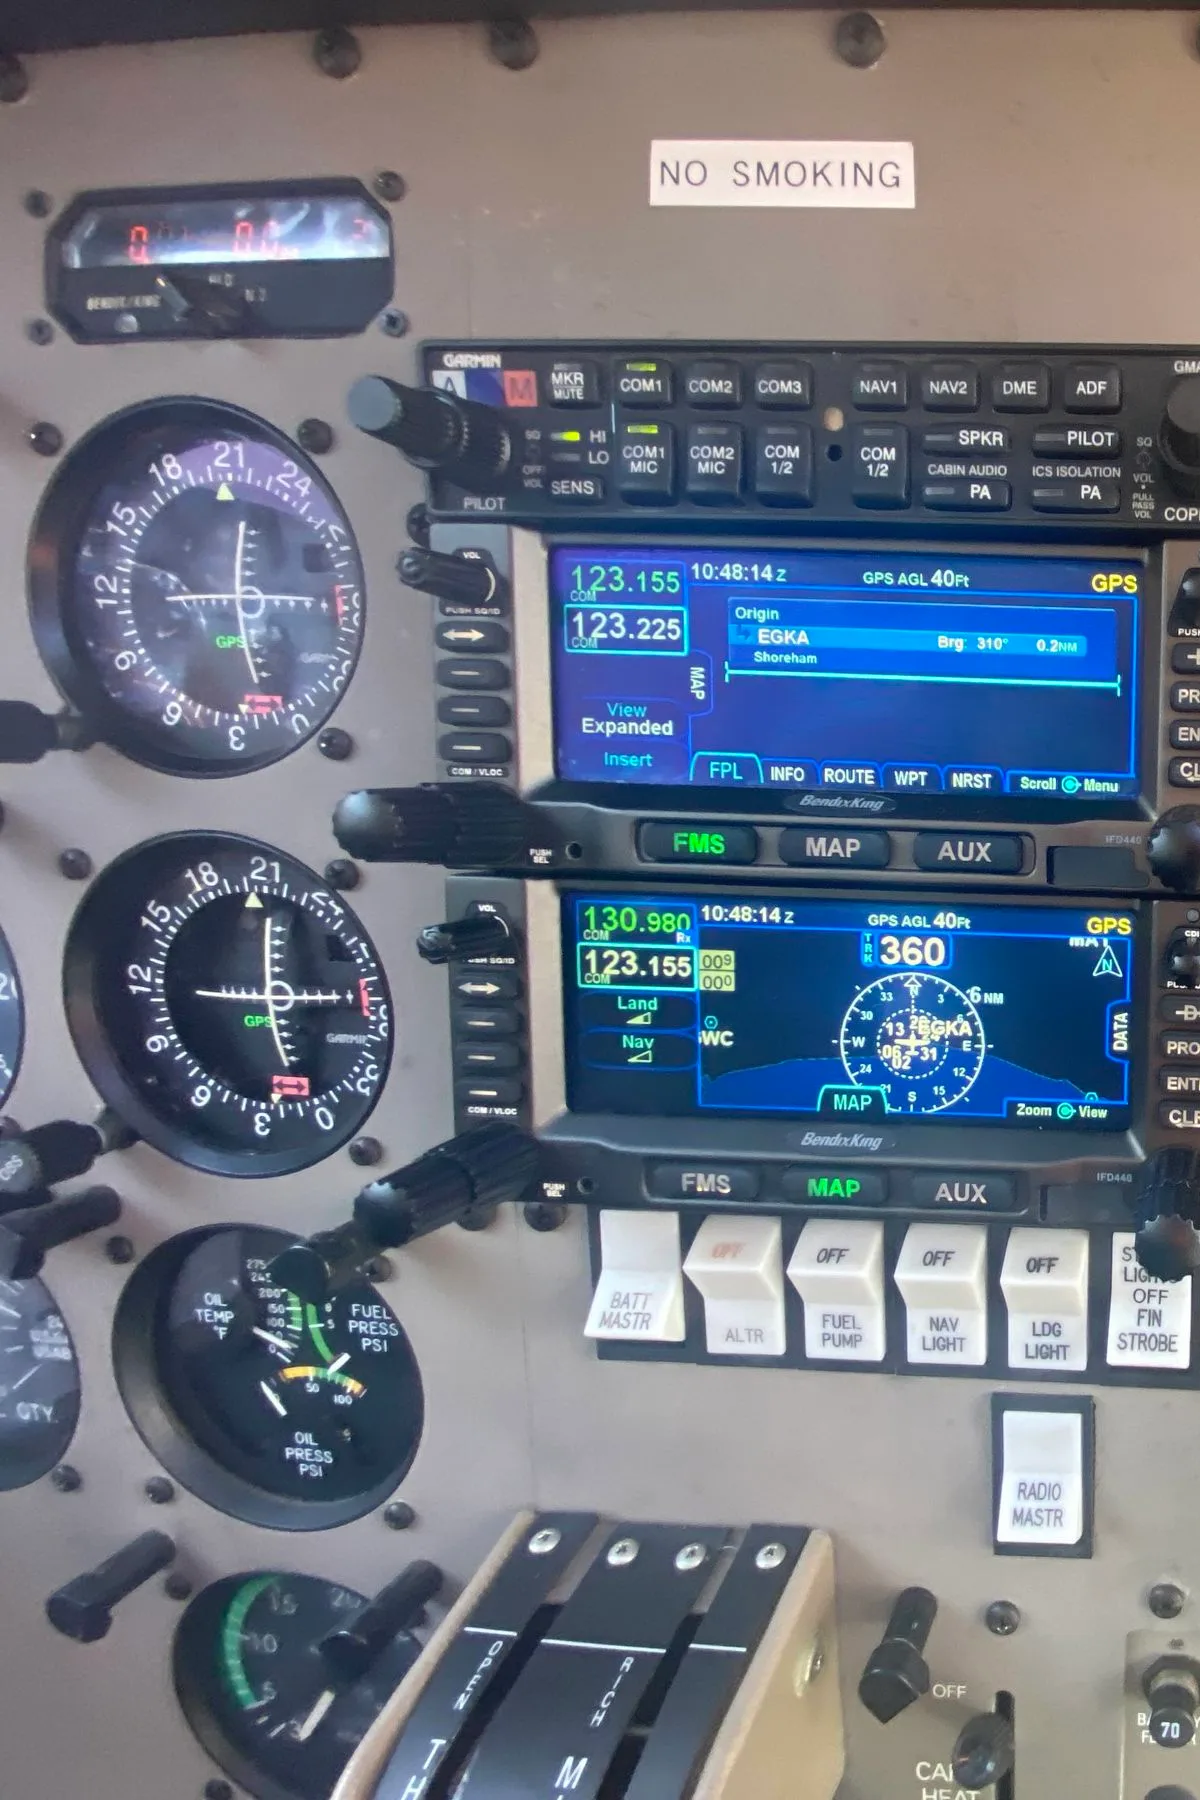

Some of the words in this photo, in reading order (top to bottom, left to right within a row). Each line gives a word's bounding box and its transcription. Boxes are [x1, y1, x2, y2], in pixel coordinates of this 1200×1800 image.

[660, 160, 708, 187] NO
[732, 160, 901, 188] SMOKING
[443, 354, 501, 368] GARMIN
[552, 372, 584, 385] MKR
[620, 378, 662, 392] COM1
[554, 388, 584, 400] MUTE
[689, 380, 732, 394] COM2
[758, 380, 802, 394] COM3
[860, 380, 897, 394] NAV1
[930, 381, 968, 394] NAV2
[1003, 381, 1037, 395] DME
[1076, 381, 1107, 395] ADF
[959, 430, 1004, 445] SPKR
[1067, 431, 1115, 447] PILOT
[213, 441, 245, 467] 21
[622, 446, 665, 459] COM1
[690, 446, 734, 459] COM2
[764, 446, 800, 458] COM
[860, 447, 896, 460] COM
[149, 453, 183, 485] 18
[630, 460, 658, 474] MIC
[698, 462, 726, 474] MIC
[928, 464, 966, 476] CABIN
[974, 464, 1008, 476] AUDIO
[1032, 466, 1053, 477] ICS
[1056, 466, 1121, 478] ISOLATION
[276, 461, 313, 497] 24
[551, 480, 594, 495] SENS
[970, 484, 991, 500] PA
[1080, 485, 1101, 500] PA
[464, 497, 505, 511] PILOT
[106, 502, 136, 537] 15
[571, 565, 680, 593] 123.155
[862, 572, 893, 585] GPS
[898, 572, 928, 587] AGL
[1091, 573, 1138, 593] GPS
[735, 607, 779, 622] Origin
[572, 612, 682, 640] 123.225
[758, 628, 810, 645] EGKA
[754, 651, 818, 664] Shoreham
[690, 666, 706, 700] MAP
[606, 702, 647, 717] View
[582, 718, 674, 737] Expanded
[604, 752, 652, 766] Insert
[709, 762, 743, 780] FPL
[770, 767, 804, 781] INFO
[824, 768, 875, 784] ROUTE
[894, 771, 927, 786] WPT
[953, 773, 991, 788] NRST
[1020, 776, 1056, 790] Scroll
[1084, 778, 1118, 792] Menu
[672, 832, 726, 855] FMS
[805, 837, 861, 859] MAP
[937, 841, 992, 863] AUX
[185, 861, 219, 892] 18
[250, 856, 280, 883] 21
[584, 906, 691, 933] 130.980
[868, 914, 898, 926] GPS
[902, 915, 930, 928] AGL
[1087, 918, 1132, 934] GPS
[880, 936, 946, 966] 360
[585, 950, 692, 977] 123.155
[618, 996, 658, 1010] Land
[1113, 1012, 1128, 1051] DATA
[622, 1035, 654, 1048] Nav
[834, 1094, 872, 1110] MAP
[1016, 1104, 1052, 1116] Zoom
[1078, 1106, 1107, 1118] View
[681, 1173, 731, 1194] FMS
[807, 1178, 861, 1197] MAP
[935, 1183, 988, 1203] AUX
[816, 1248, 850, 1263] OFF
[922, 1250, 955, 1266] OFF
[1026, 1257, 1059, 1273] OFF
[204, 1292, 227, 1307] OIL
[610, 1292, 652, 1309] BATT
[1133, 1289, 1169, 1304] OFF
[194, 1309, 234, 1323] TEMP
[352, 1304, 392, 1319] FUEL
[1137, 1309, 1162, 1327] FIN
[349, 1320, 399, 1337] PRESS
[599, 1312, 652, 1330] MASTR
[822, 1314, 862, 1330] FUEL
[929, 1317, 959, 1332] NAV
[1031, 1321, 1062, 1337] LDG
[725, 1328, 764, 1343] ALTR
[822, 1332, 862, 1348] PUMP
[1117, 1333, 1178, 1352] STROBE
[361, 1339, 388, 1352] PSI
[922, 1336, 967, 1352] LIGHT
[1024, 1344, 1070, 1360] LIGHT
[294, 1432, 318, 1446] OIL
[285, 1448, 333, 1464] PRESS
[299, 1465, 323, 1477] PSI
[1017, 1482, 1062, 1501] RADIO
[1012, 1508, 1063, 1527] MASTR
[454, 1640, 503, 1711] OPEN
[590, 1656, 634, 1728] RICH
[932, 1684, 967, 1699] OFF
[1161, 1720, 1181, 1739] 70
